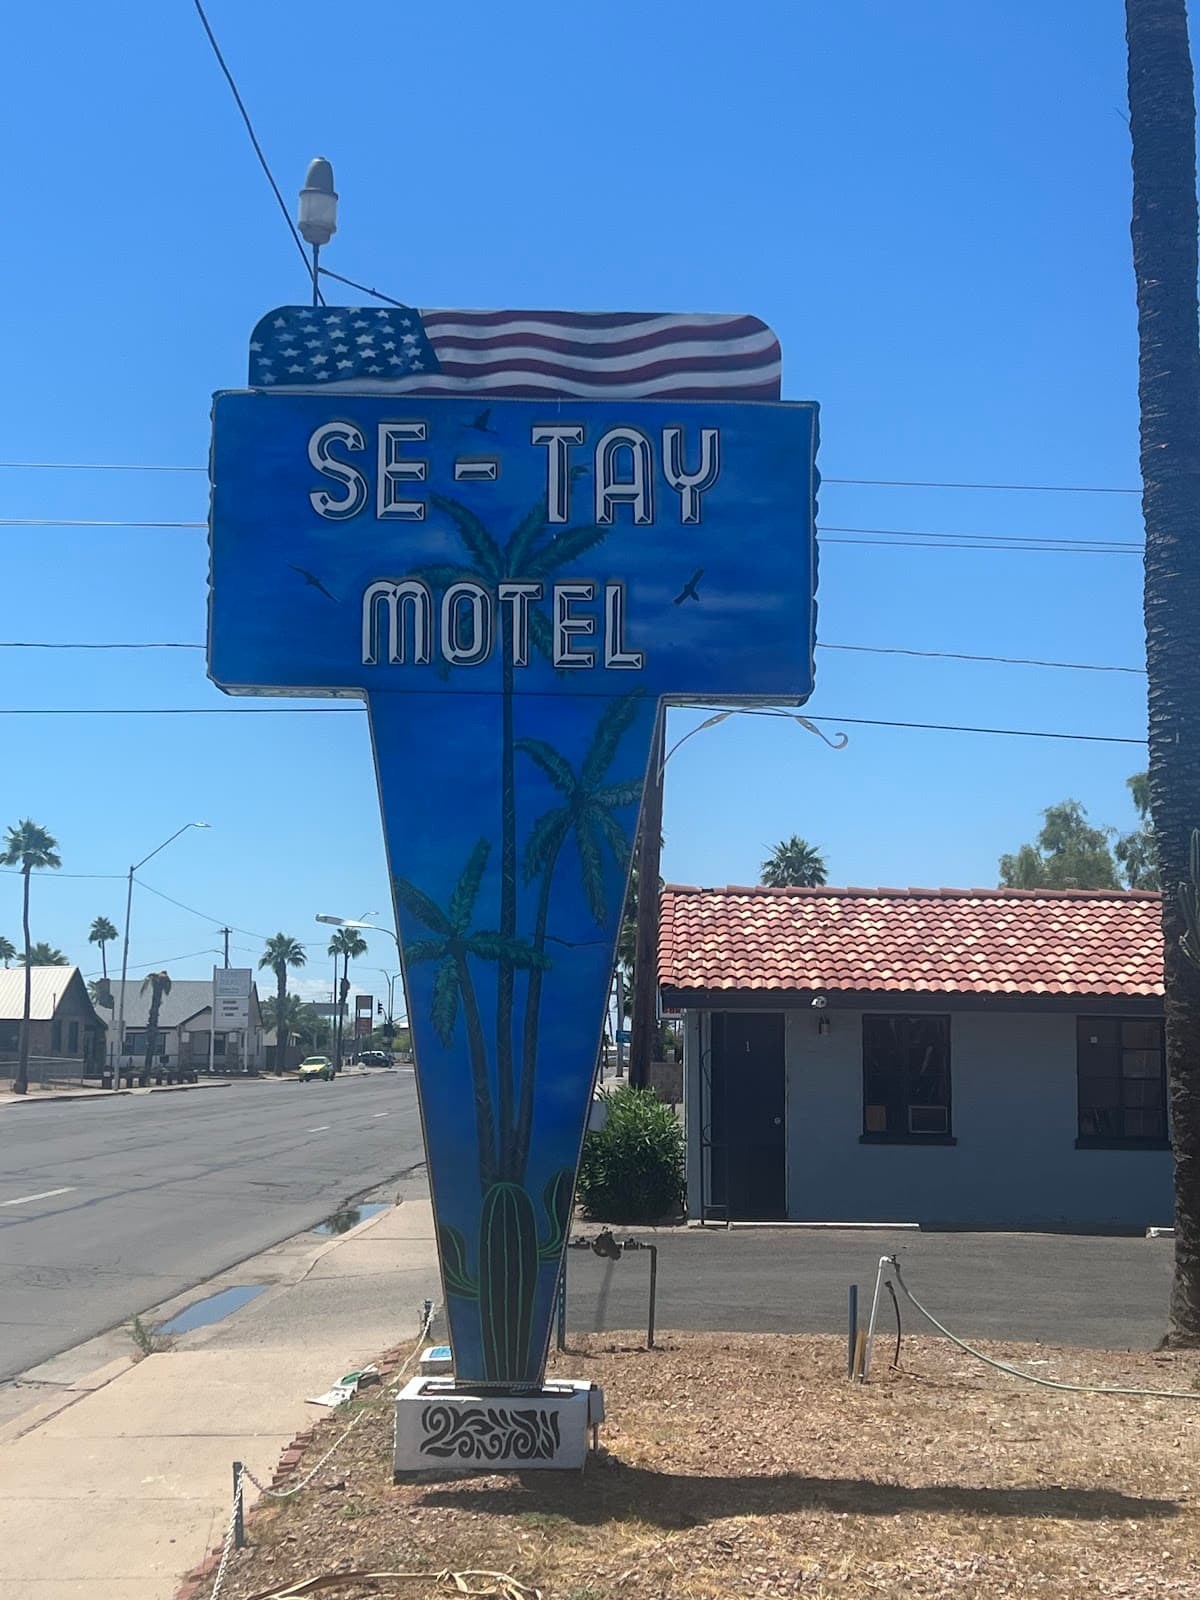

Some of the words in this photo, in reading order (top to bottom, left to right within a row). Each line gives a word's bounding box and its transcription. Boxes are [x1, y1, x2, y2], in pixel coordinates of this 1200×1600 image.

[307, 421, 427, 521] SE
[531, 426, 720, 525] TAY
[362, 580, 645, 670] MOTEL
